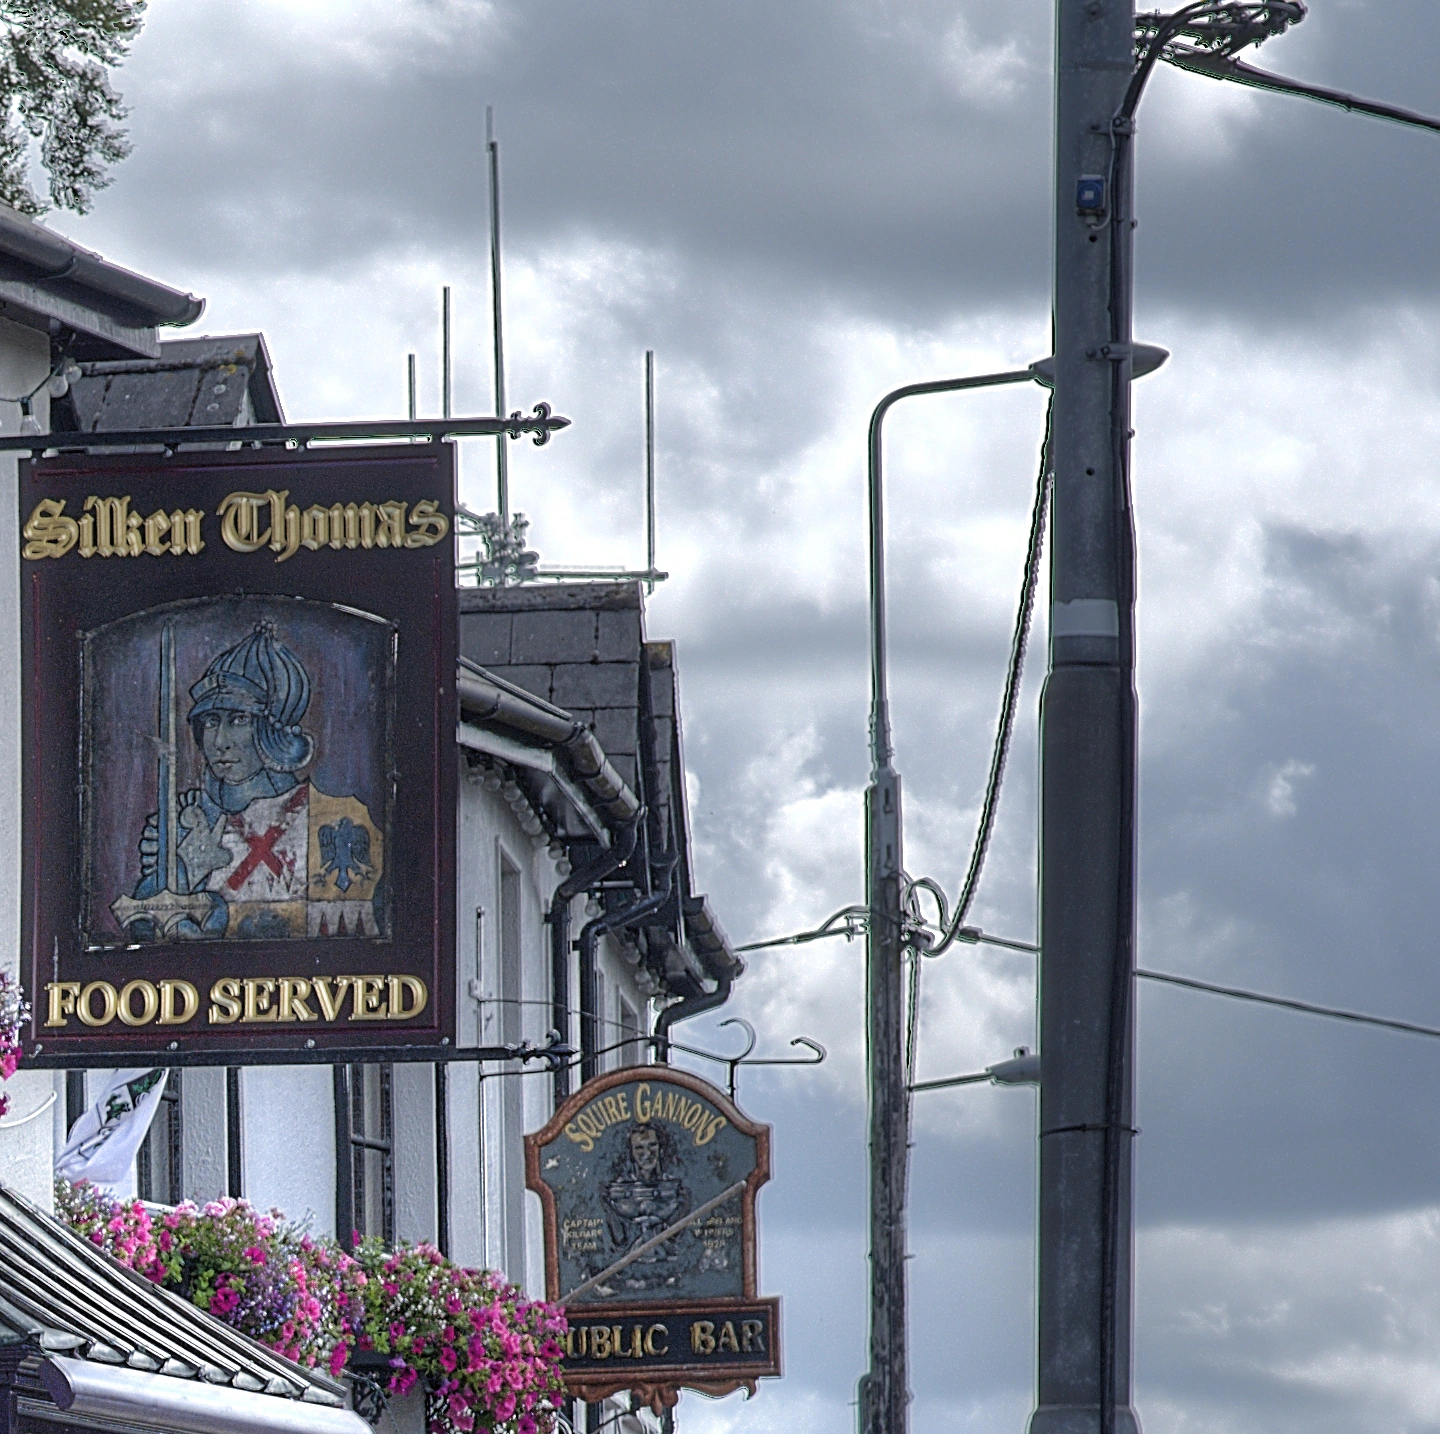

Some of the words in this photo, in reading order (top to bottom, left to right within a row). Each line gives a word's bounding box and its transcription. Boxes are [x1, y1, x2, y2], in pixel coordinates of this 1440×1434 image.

[22, 494, 205, 560] Silken
[216, 489, 450, 562] Thomas
[43, 981, 201, 1029] FOOD
[207, 974, 429, 1027] SERVED
[563, 1091, 632, 1153] SQUIRE
[633, 1082, 728, 1147] GANNONS
[570, 1240, 598, 1251] TEAM
[566, 1322, 669, 1359] UBLIC
[689, 1319, 766, 1356] BAR
